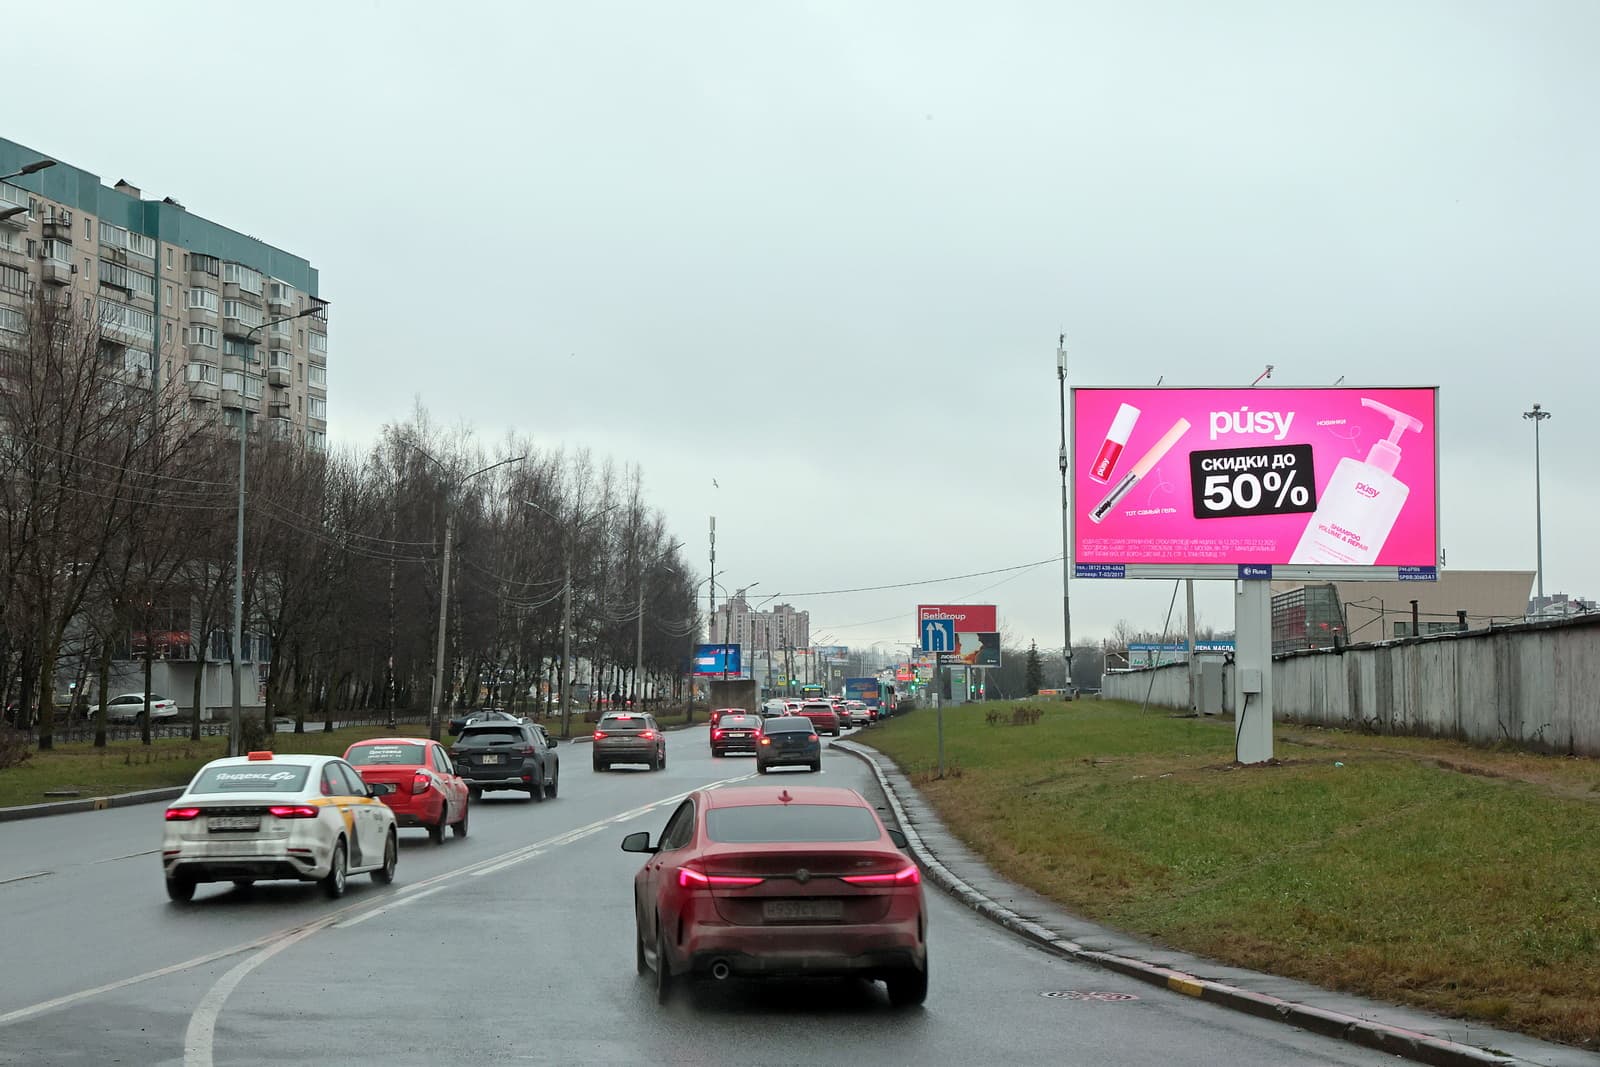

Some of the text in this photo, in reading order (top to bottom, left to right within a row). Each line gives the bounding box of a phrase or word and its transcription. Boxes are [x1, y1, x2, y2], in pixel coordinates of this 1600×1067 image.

[1209, 406, 1295, 441] púsy
[1203, 469, 1309, 511] 50%
[1318, 524, 1341, 540] VOLUME
[1347, 538, 1369, 552] REPAIR
[1330, 523, 1361, 542] SHAMPOO
[216, 772, 270, 781] Яндекс
